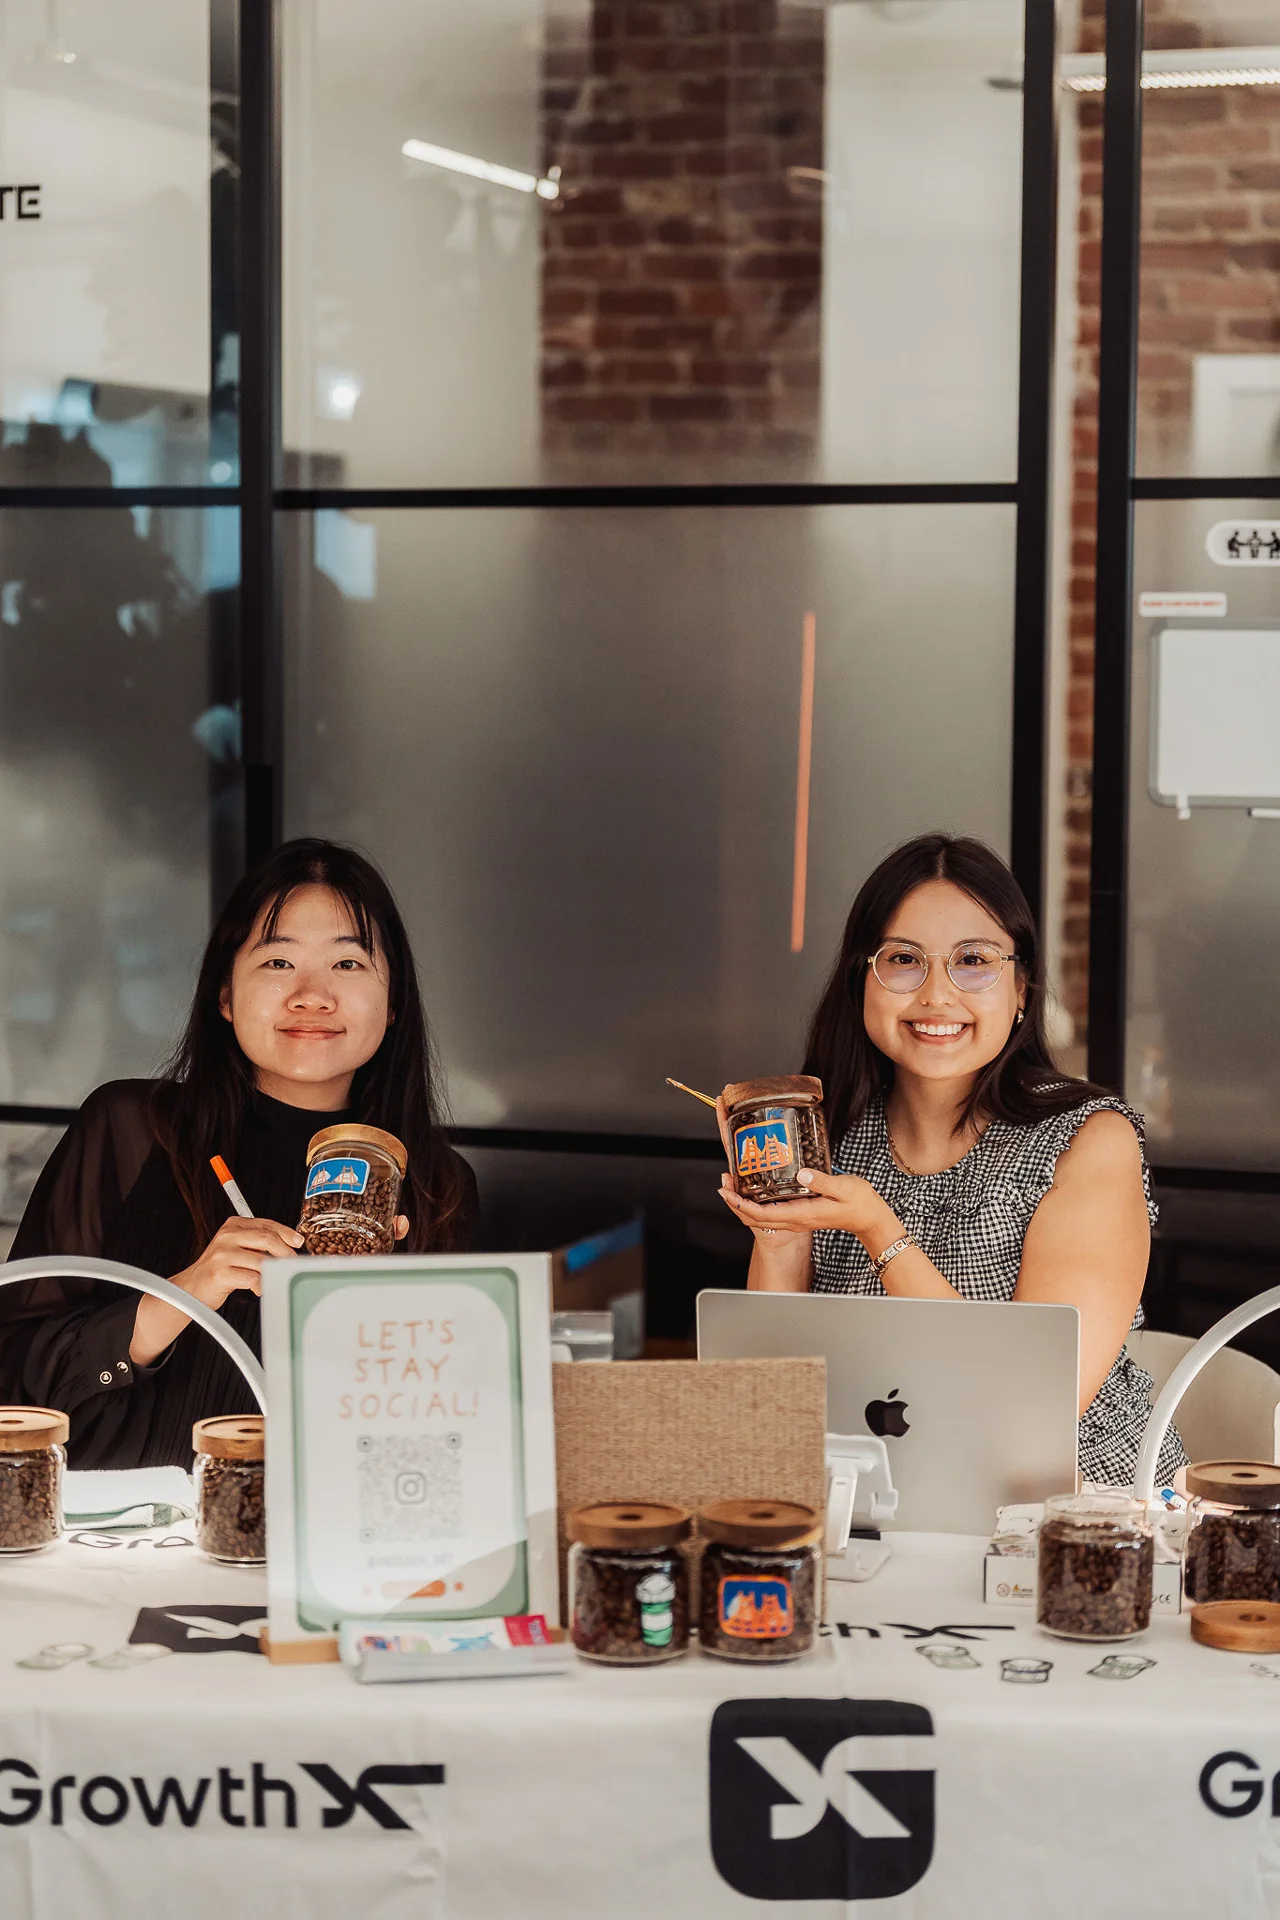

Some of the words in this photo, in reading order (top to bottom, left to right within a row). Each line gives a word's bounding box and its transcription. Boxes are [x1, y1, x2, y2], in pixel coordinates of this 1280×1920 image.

[357, 1319, 455, 1351] LET'S
[354, 1353, 450, 1384] STAY
[338, 1389, 479, 1420] SOCIAL!
